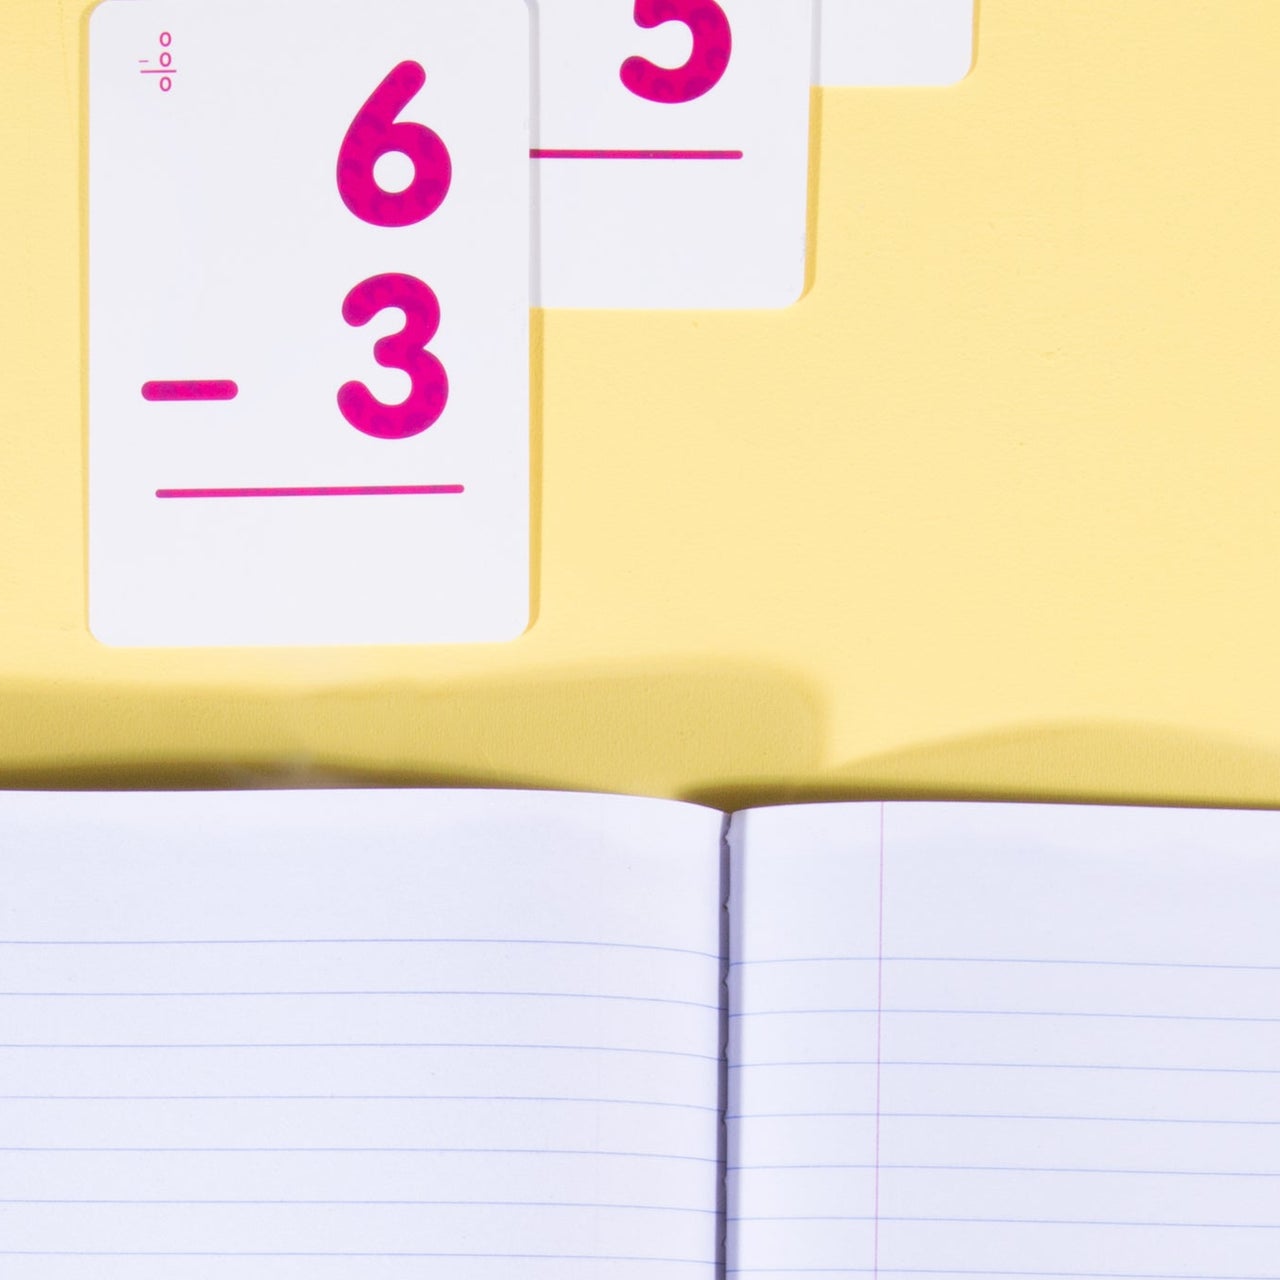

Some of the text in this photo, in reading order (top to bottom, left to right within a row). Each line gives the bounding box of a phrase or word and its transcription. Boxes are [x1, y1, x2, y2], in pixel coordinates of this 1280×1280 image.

[159, 31, 172, 47] 0
[159, 52, 172, 67] 0
[159, 76, 172, 92] 0
[335, 60, 453, 228] 6
[337, 272, 449, 440] 3
